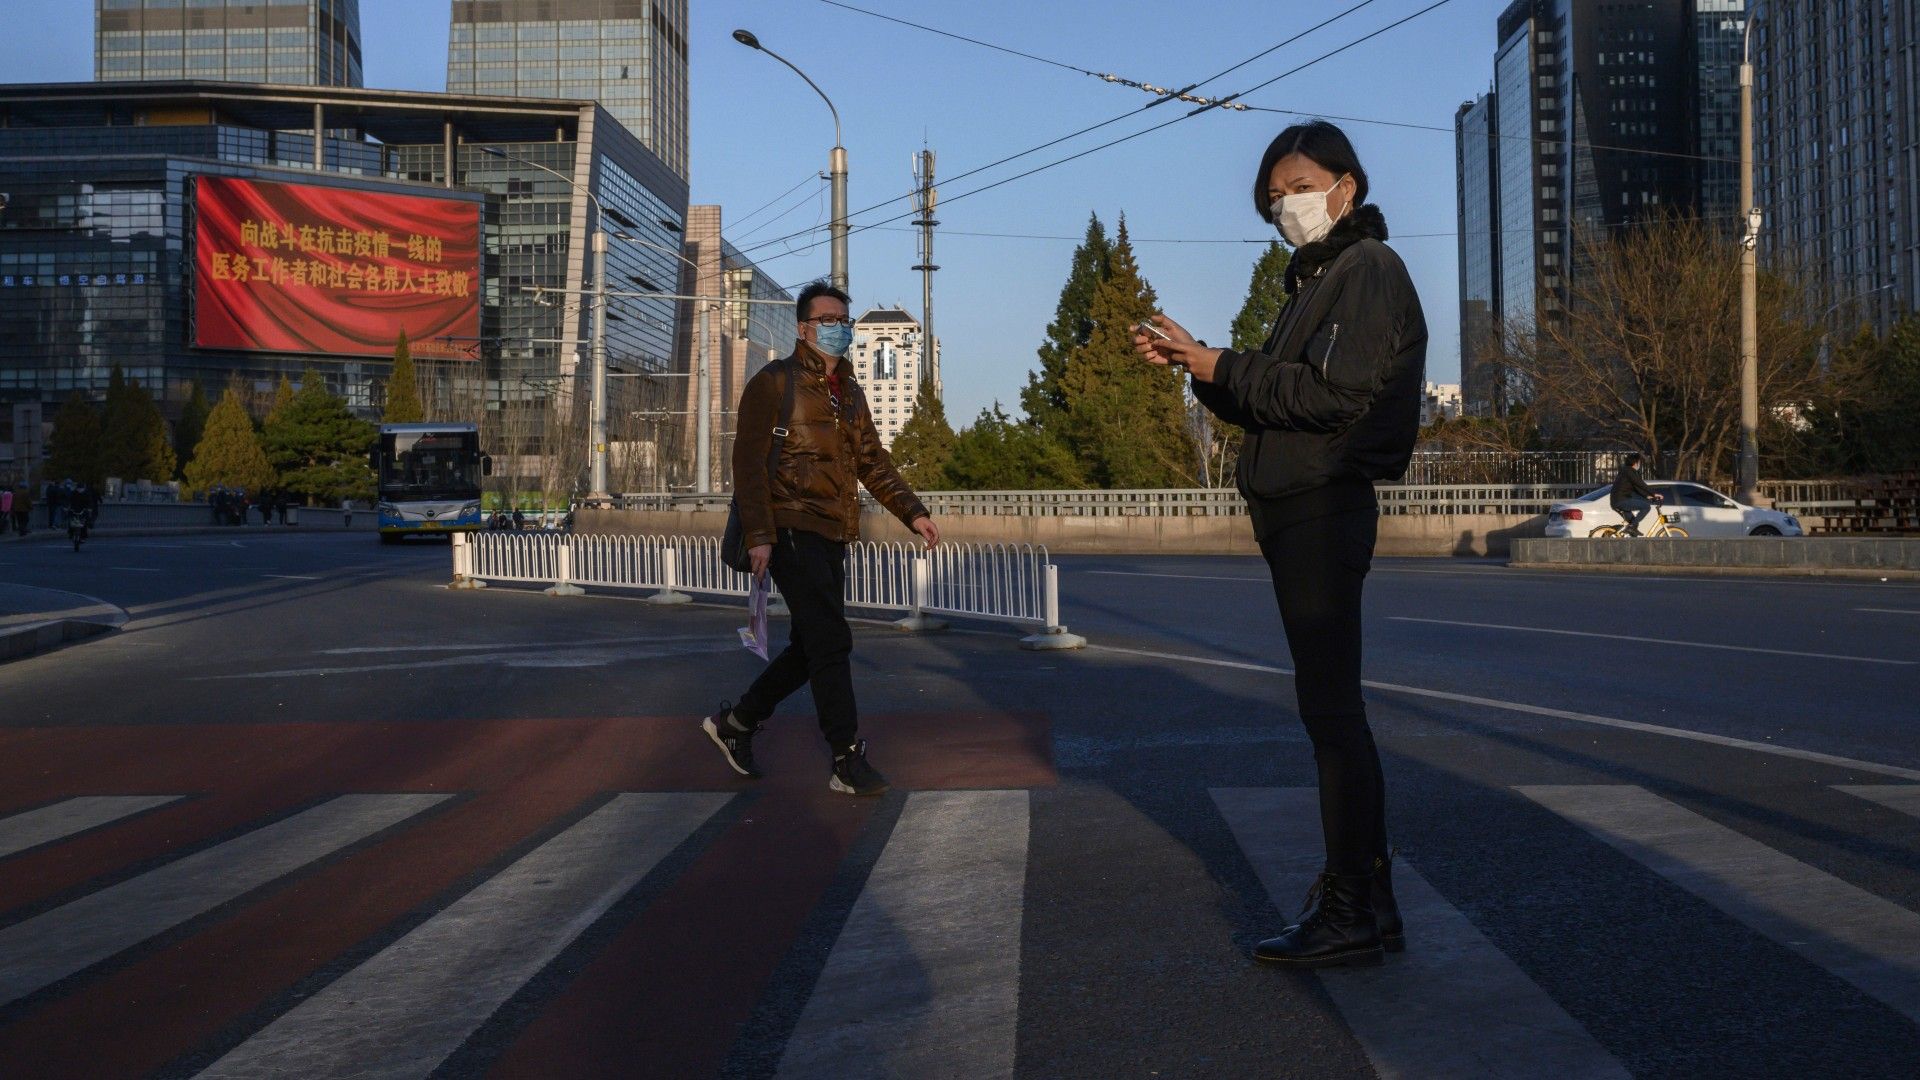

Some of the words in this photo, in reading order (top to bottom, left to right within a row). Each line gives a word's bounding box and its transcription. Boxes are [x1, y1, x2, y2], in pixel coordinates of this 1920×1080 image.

[241, 219, 442, 262] 向战斗在抗击疫情一线的
[212, 252, 469, 297] 医务工作者和社会各界人士致敬
